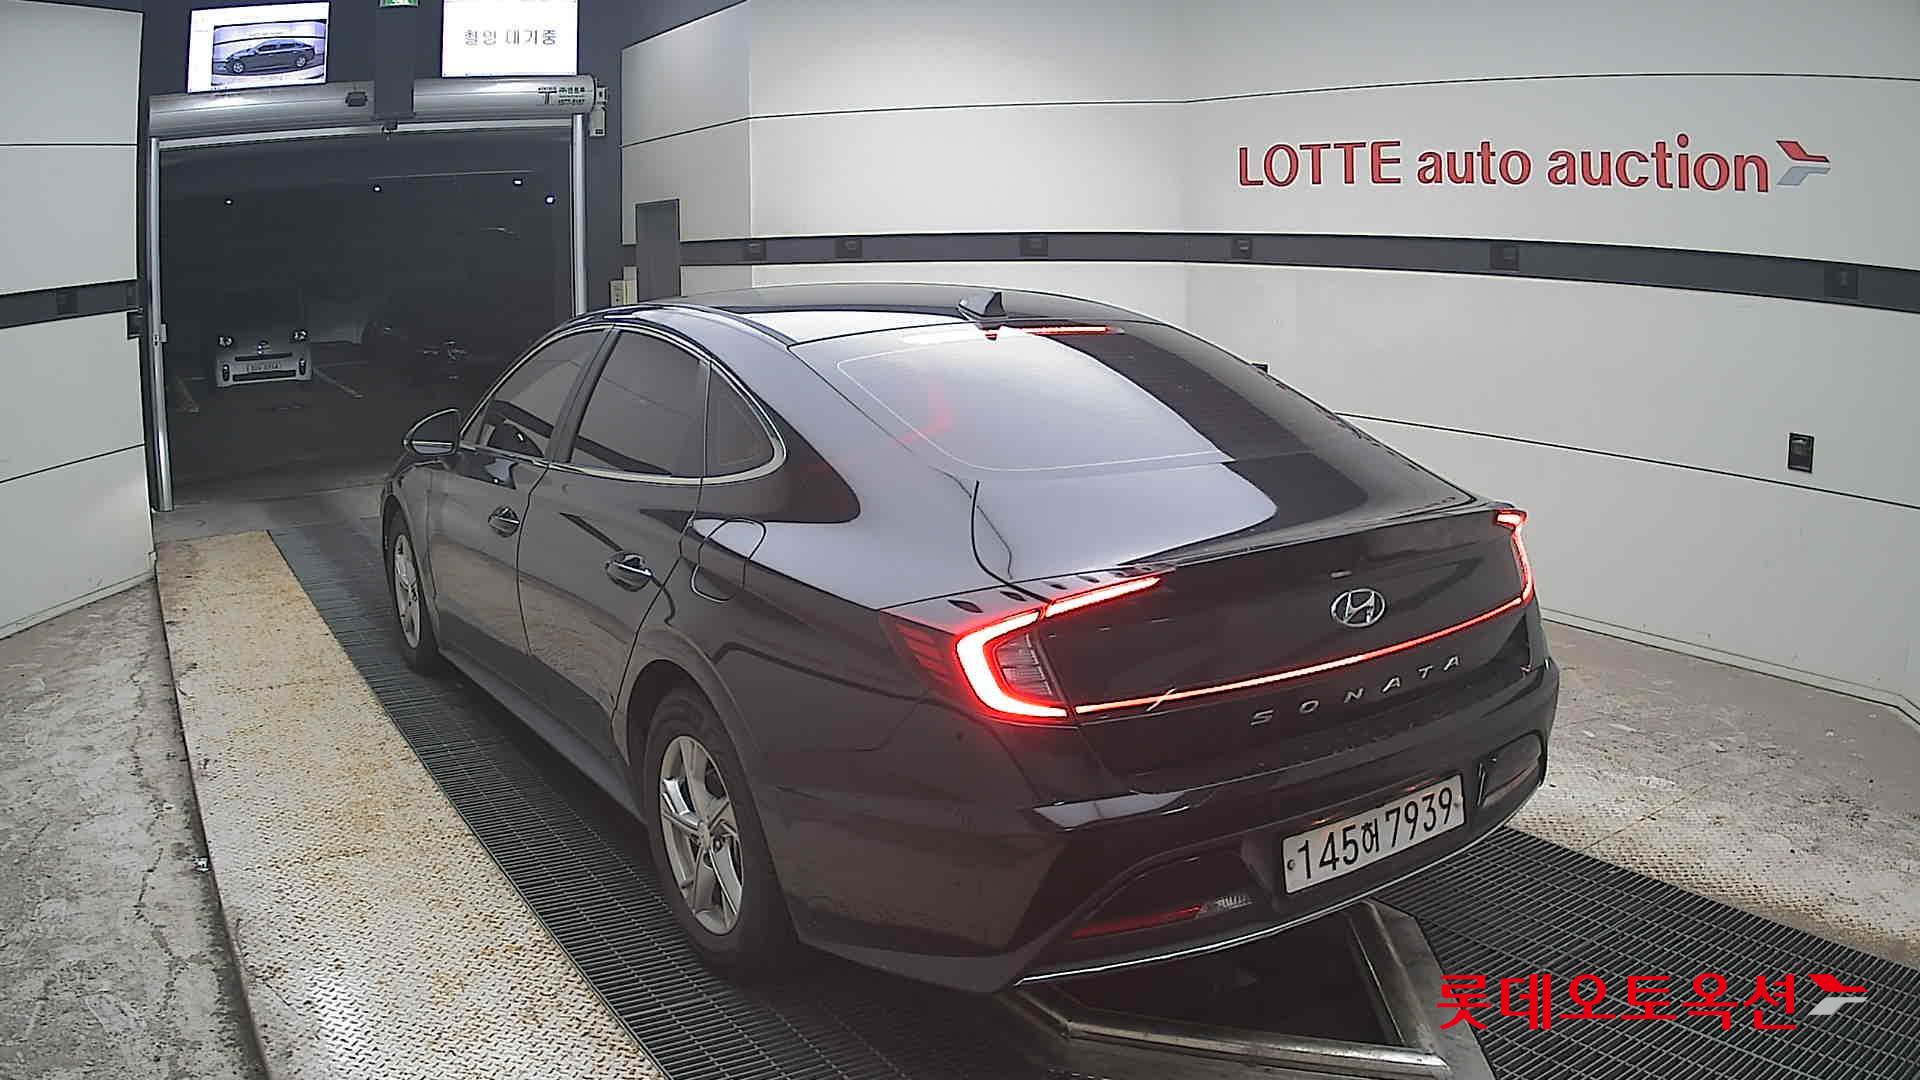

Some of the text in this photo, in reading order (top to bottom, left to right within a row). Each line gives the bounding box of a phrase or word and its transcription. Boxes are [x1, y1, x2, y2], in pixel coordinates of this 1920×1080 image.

[505, 28, 557, 47] 대기중
[1238, 132, 1770, 193] LOTTE auto auction
[1249, 654, 1461, 726] SONATA
